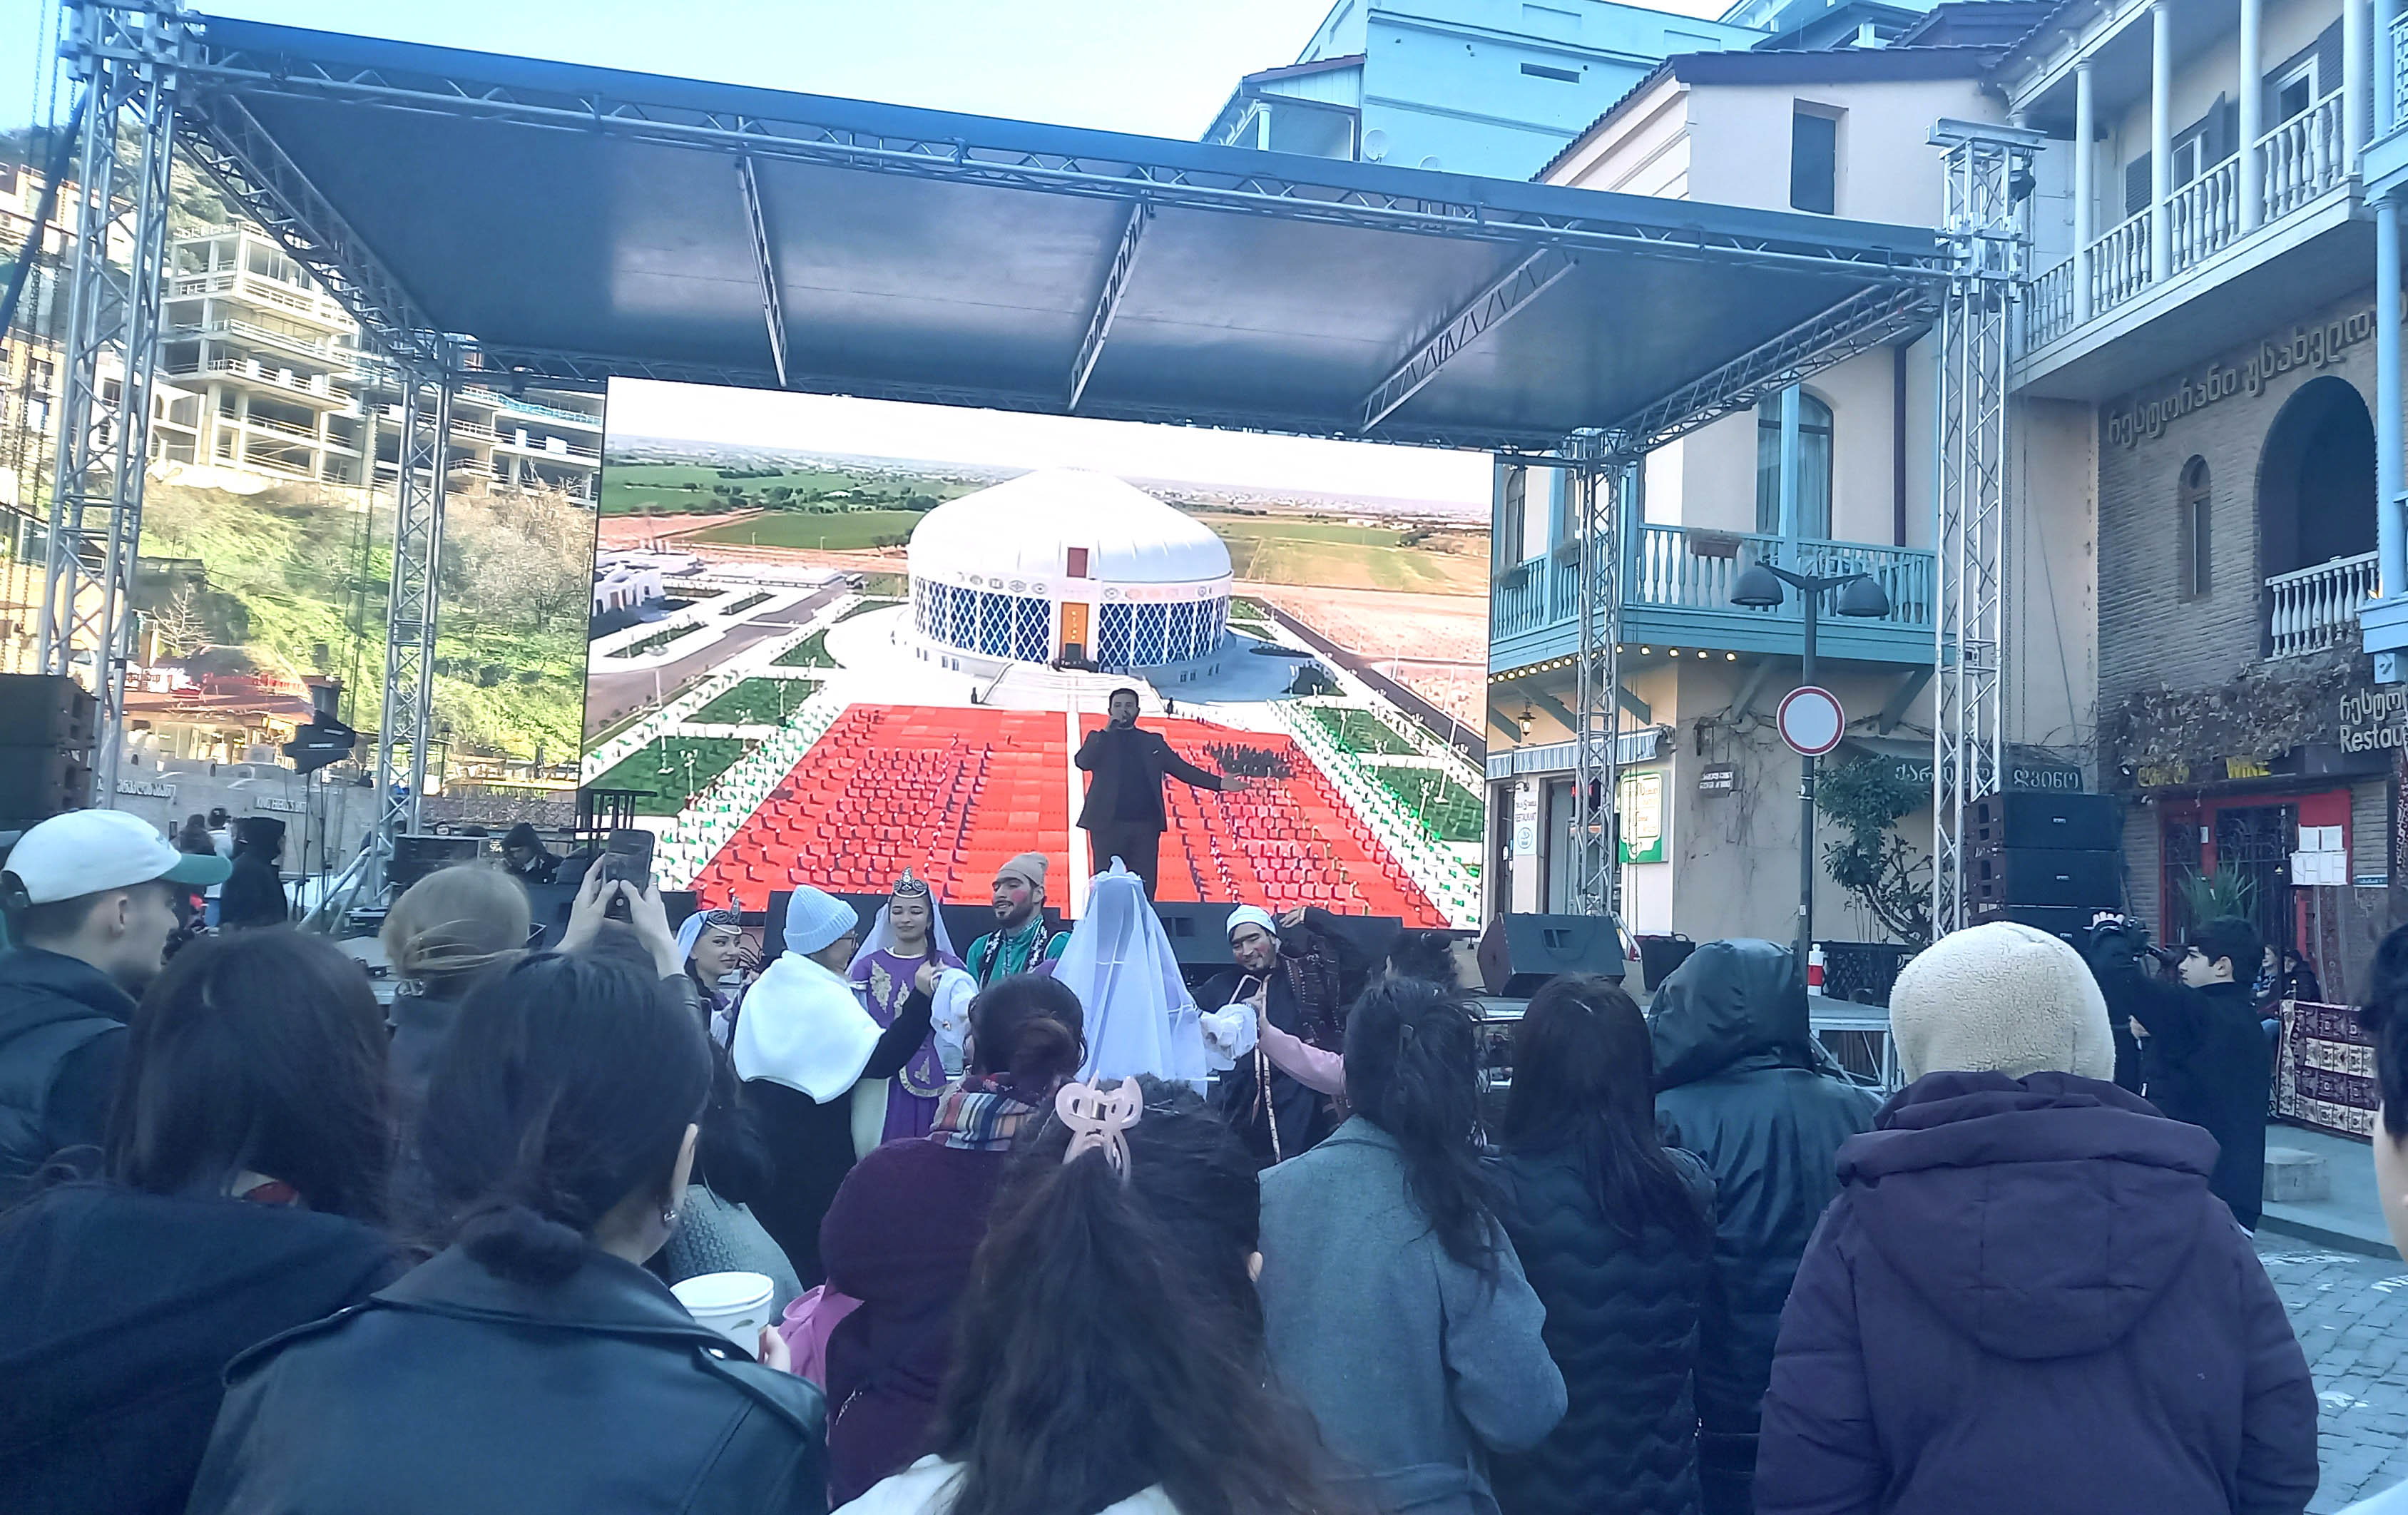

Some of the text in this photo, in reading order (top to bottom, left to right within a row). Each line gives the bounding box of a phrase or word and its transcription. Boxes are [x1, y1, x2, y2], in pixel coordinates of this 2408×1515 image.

[2245, 291, 2407, 397] უსახელო
[2340, 688, 2402, 725] რესტო
[2340, 723, 2402, 754] Restau
[2014, 767, 2078, 789] ღვინო
